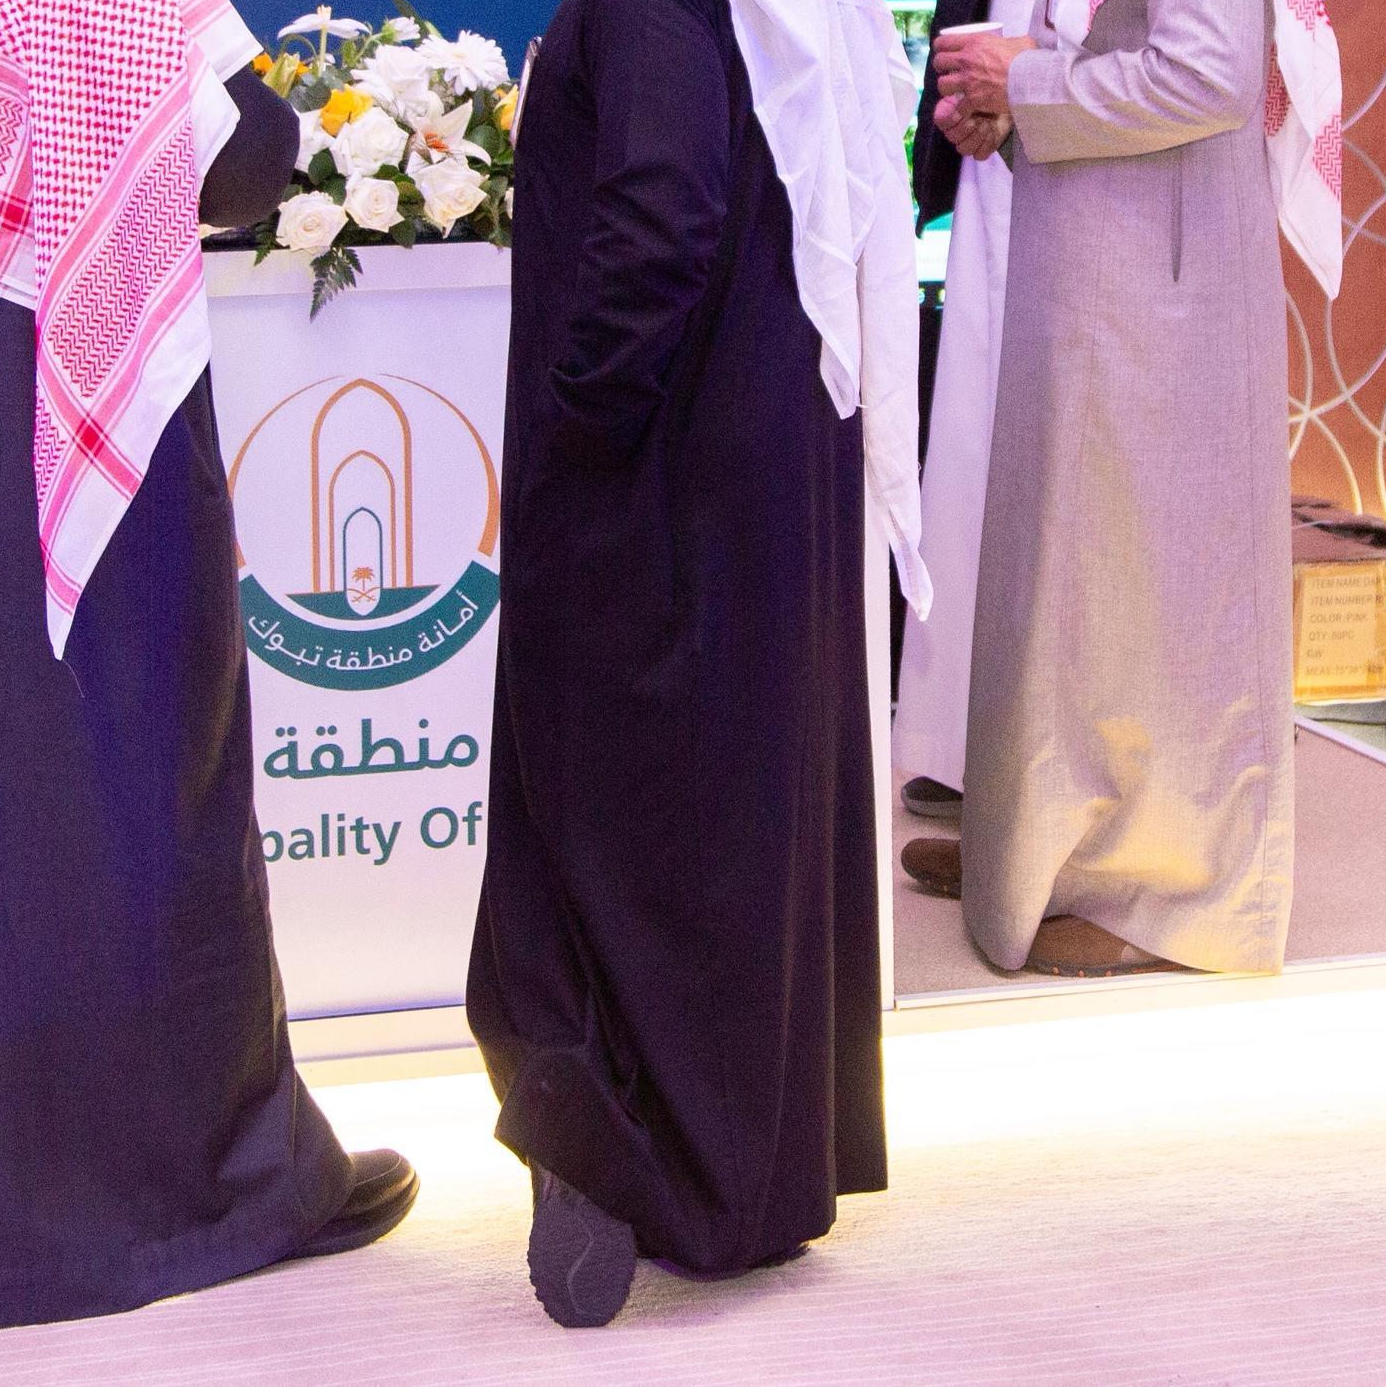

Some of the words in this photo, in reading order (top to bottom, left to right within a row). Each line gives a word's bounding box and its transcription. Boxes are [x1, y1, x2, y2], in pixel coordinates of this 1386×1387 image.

[247, 613, 323, 668] تبوك
[417, 588, 479, 654] أمانة
[325, 644, 414, 673] منطقة
[263, 717, 480, 781] منطقة
[419, 800, 484, 850] Of
